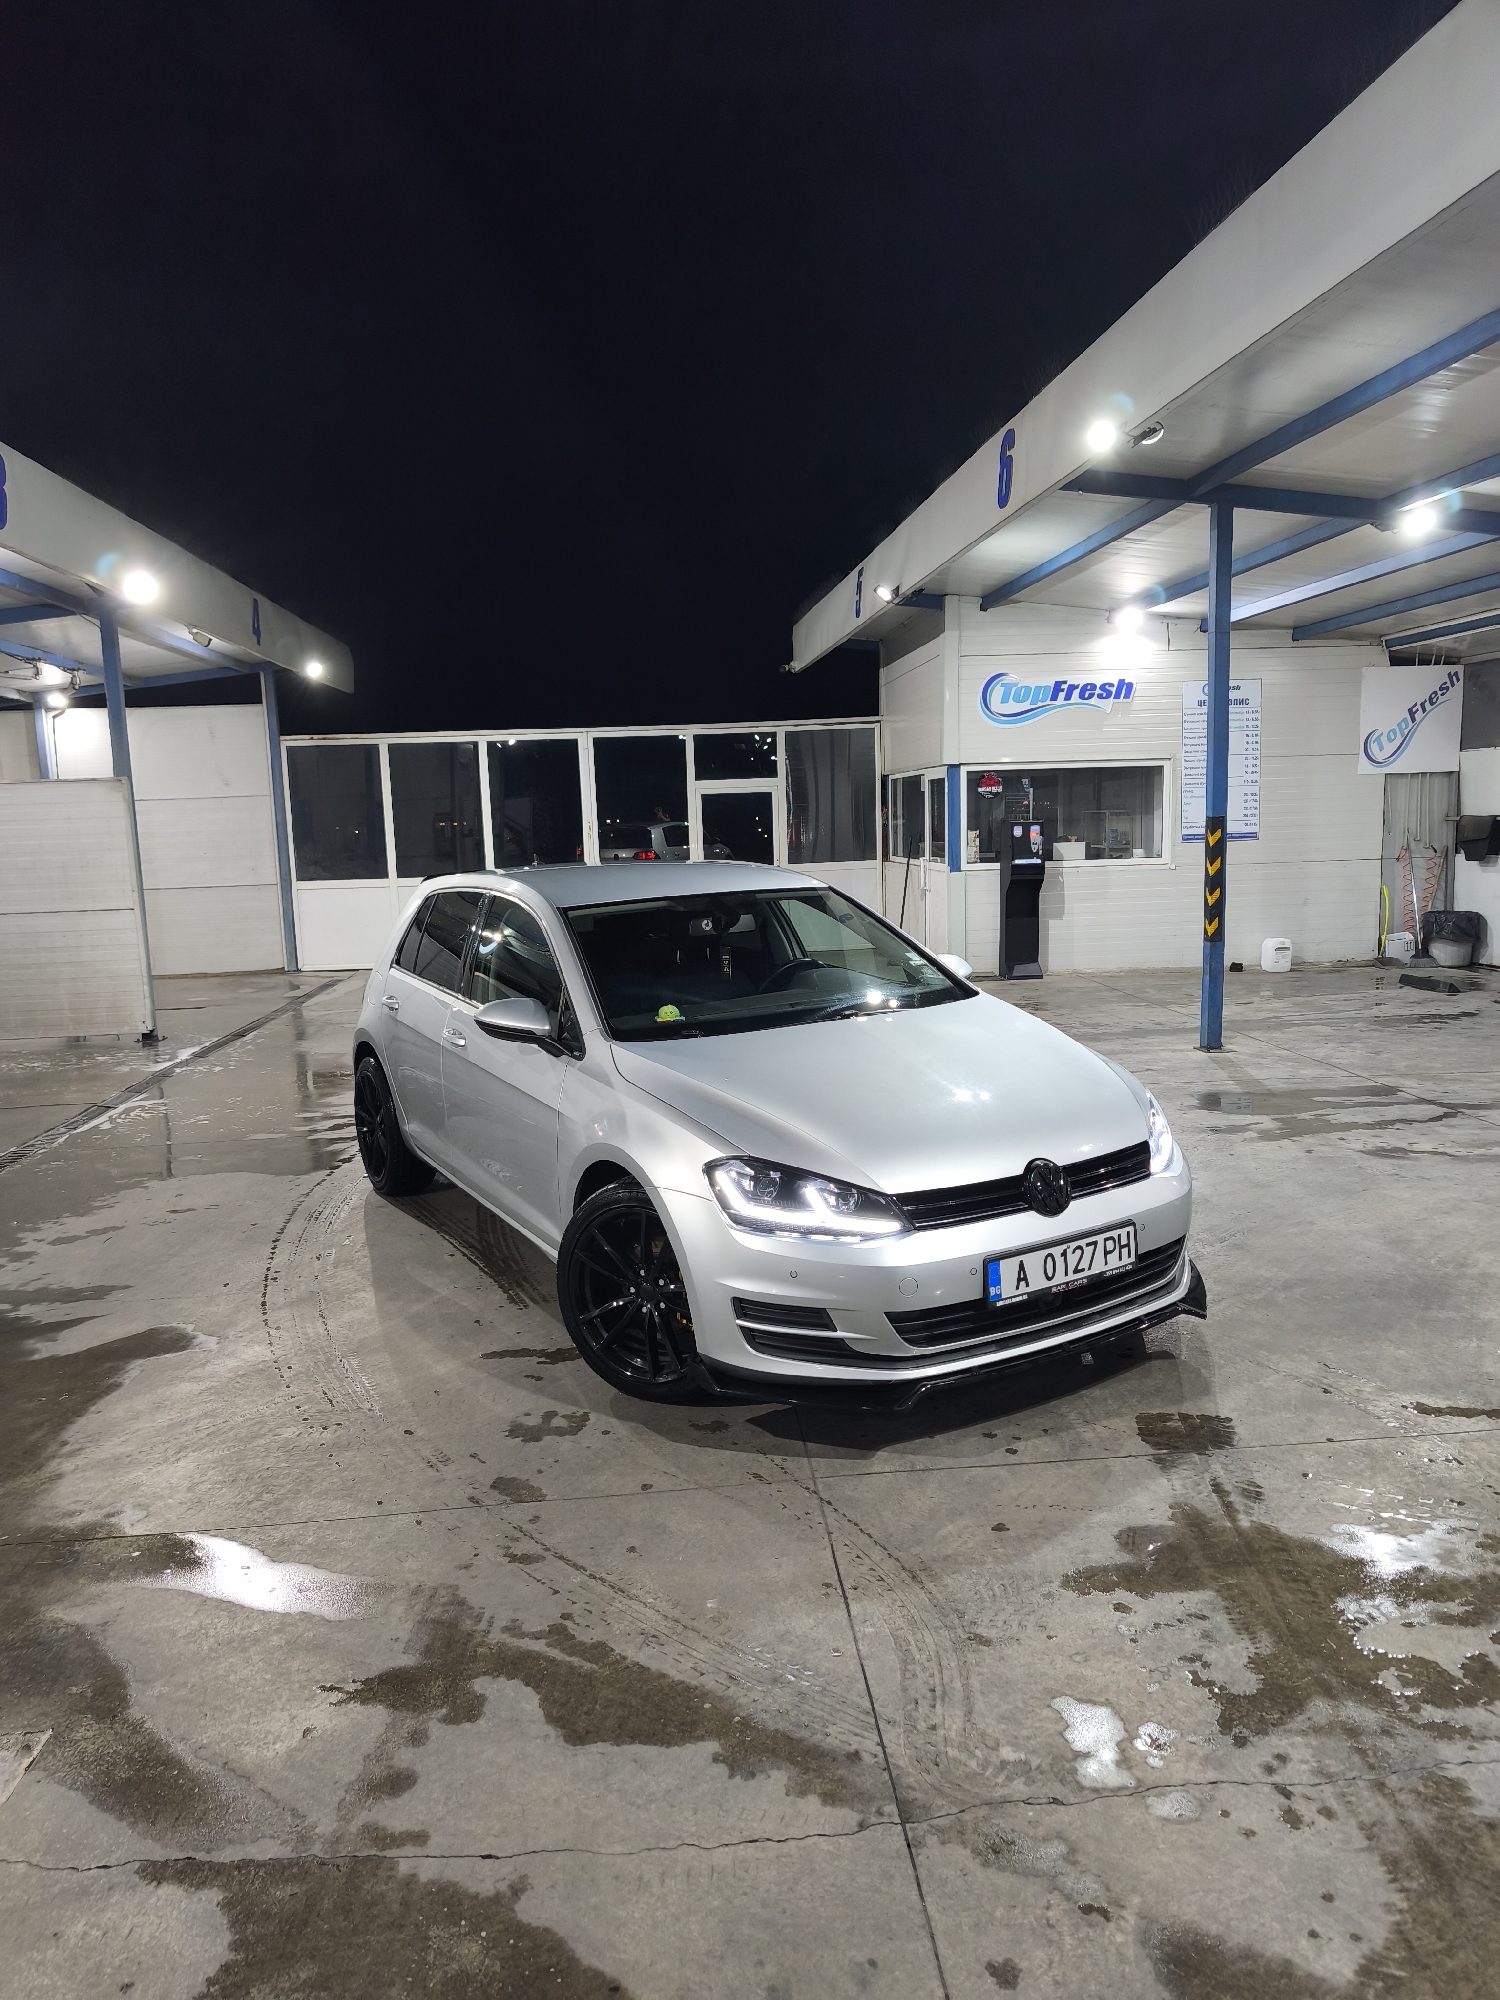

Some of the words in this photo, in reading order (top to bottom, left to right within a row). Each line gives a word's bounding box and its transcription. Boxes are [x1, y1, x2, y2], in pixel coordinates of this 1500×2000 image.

[997, 428, 1015, 509] 6
[854, 567, 864, 618] 5
[252, 598, 262, 647] 4
[1000, 678, 1134, 705] TopFresh
[1373, 670, 1461, 752] TopFresh
[1015, 1259, 1030, 1291] A
[1043, 1240, 1099, 1282] 0127
[1103, 1230, 1132, 1266] PH
[989, 1285, 1001, 1297] BG
